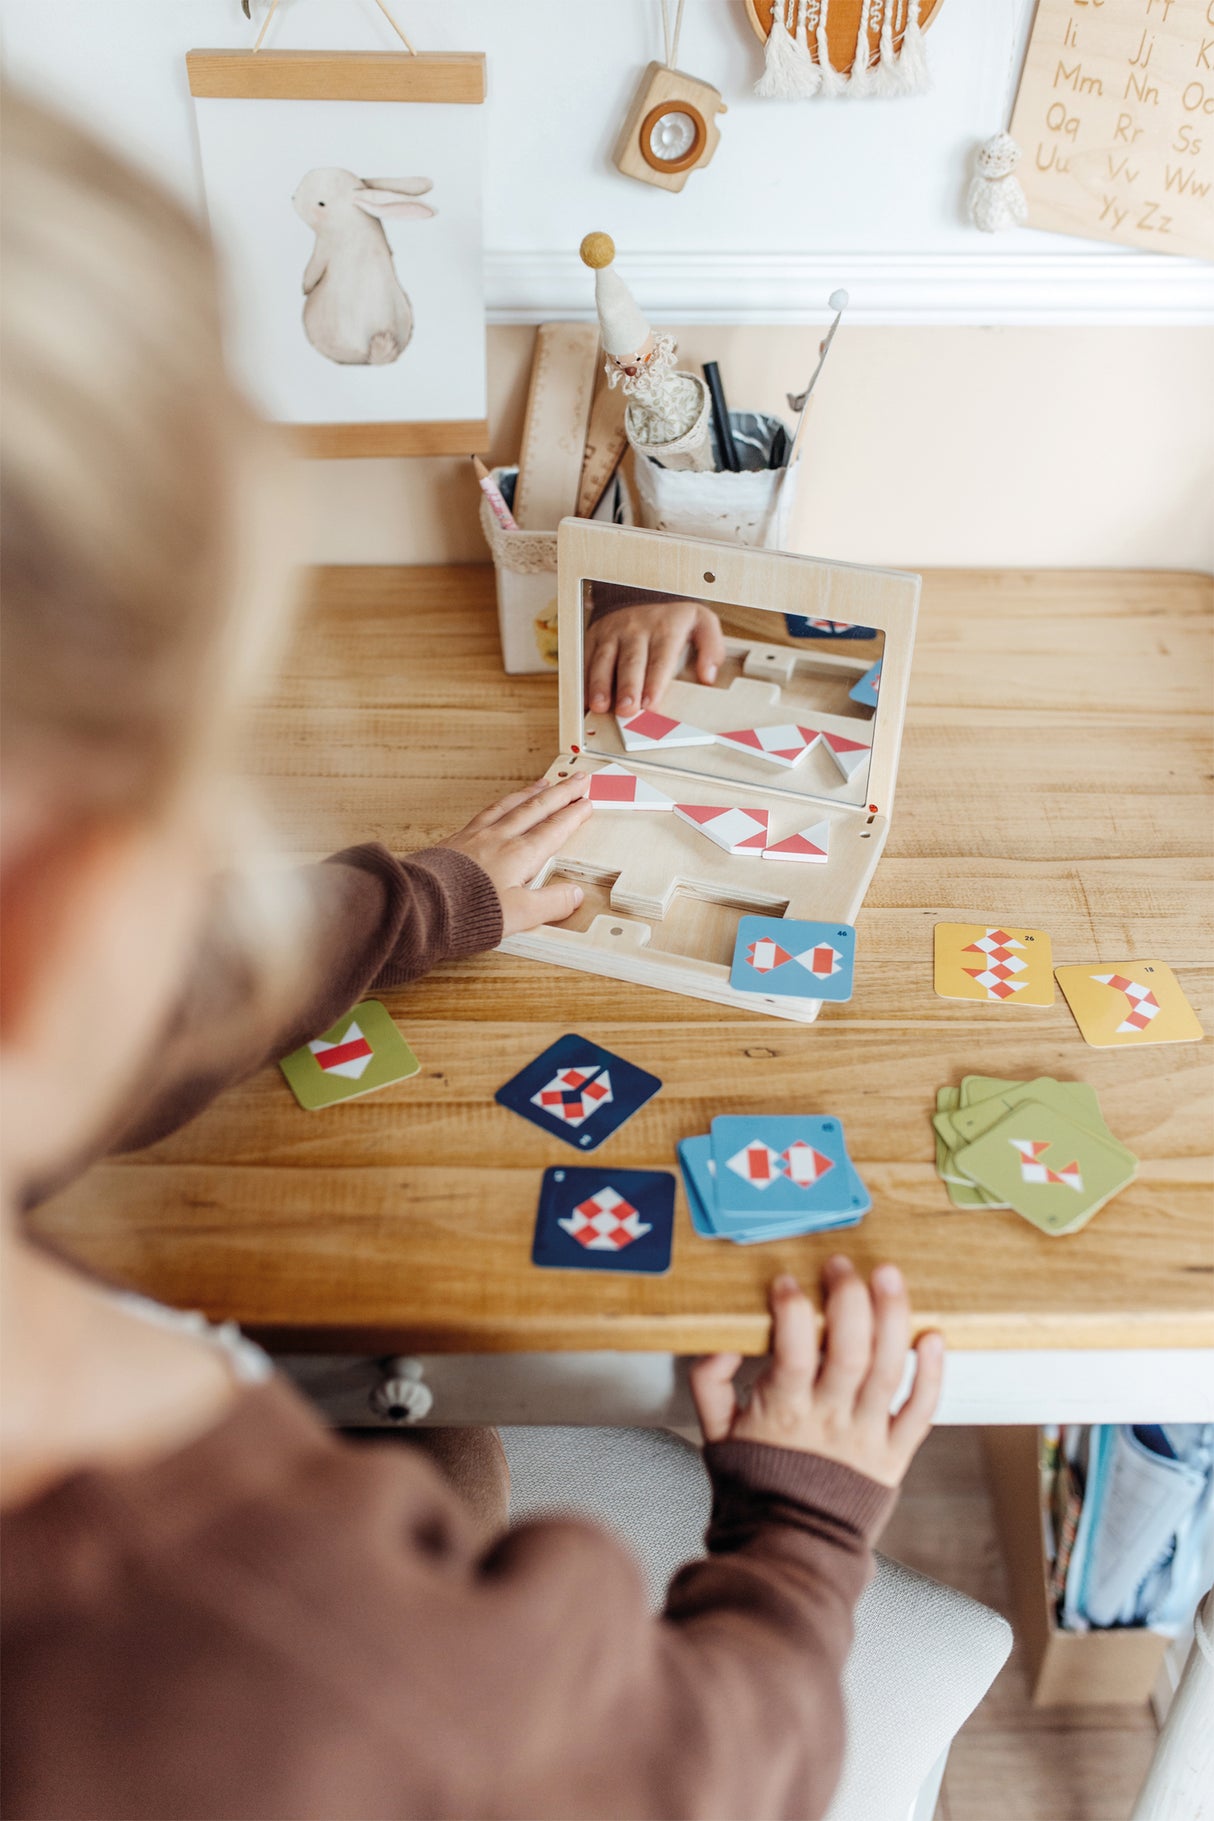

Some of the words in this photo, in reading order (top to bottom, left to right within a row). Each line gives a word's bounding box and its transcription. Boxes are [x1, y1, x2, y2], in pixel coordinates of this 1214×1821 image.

[1128, 29, 1156, 69] Jj
[1195, 37, 1214, 70] K
[1053, 60, 1103, 96] Mm
[1124, 72, 1159, 105] Nn
[1046, 102, 1080, 142] Qq
[1113, 113, 1145, 143] Rr
[1172, 125, 1203, 155] Ss
[1035, 143, 1070, 174] Uu
[1107, 153, 1140, 183] Vv
[1164, 164, 1212, 197] Ww
[1099, 194, 1130, 231] Yy
[1136, 201, 1173, 233] Zz
